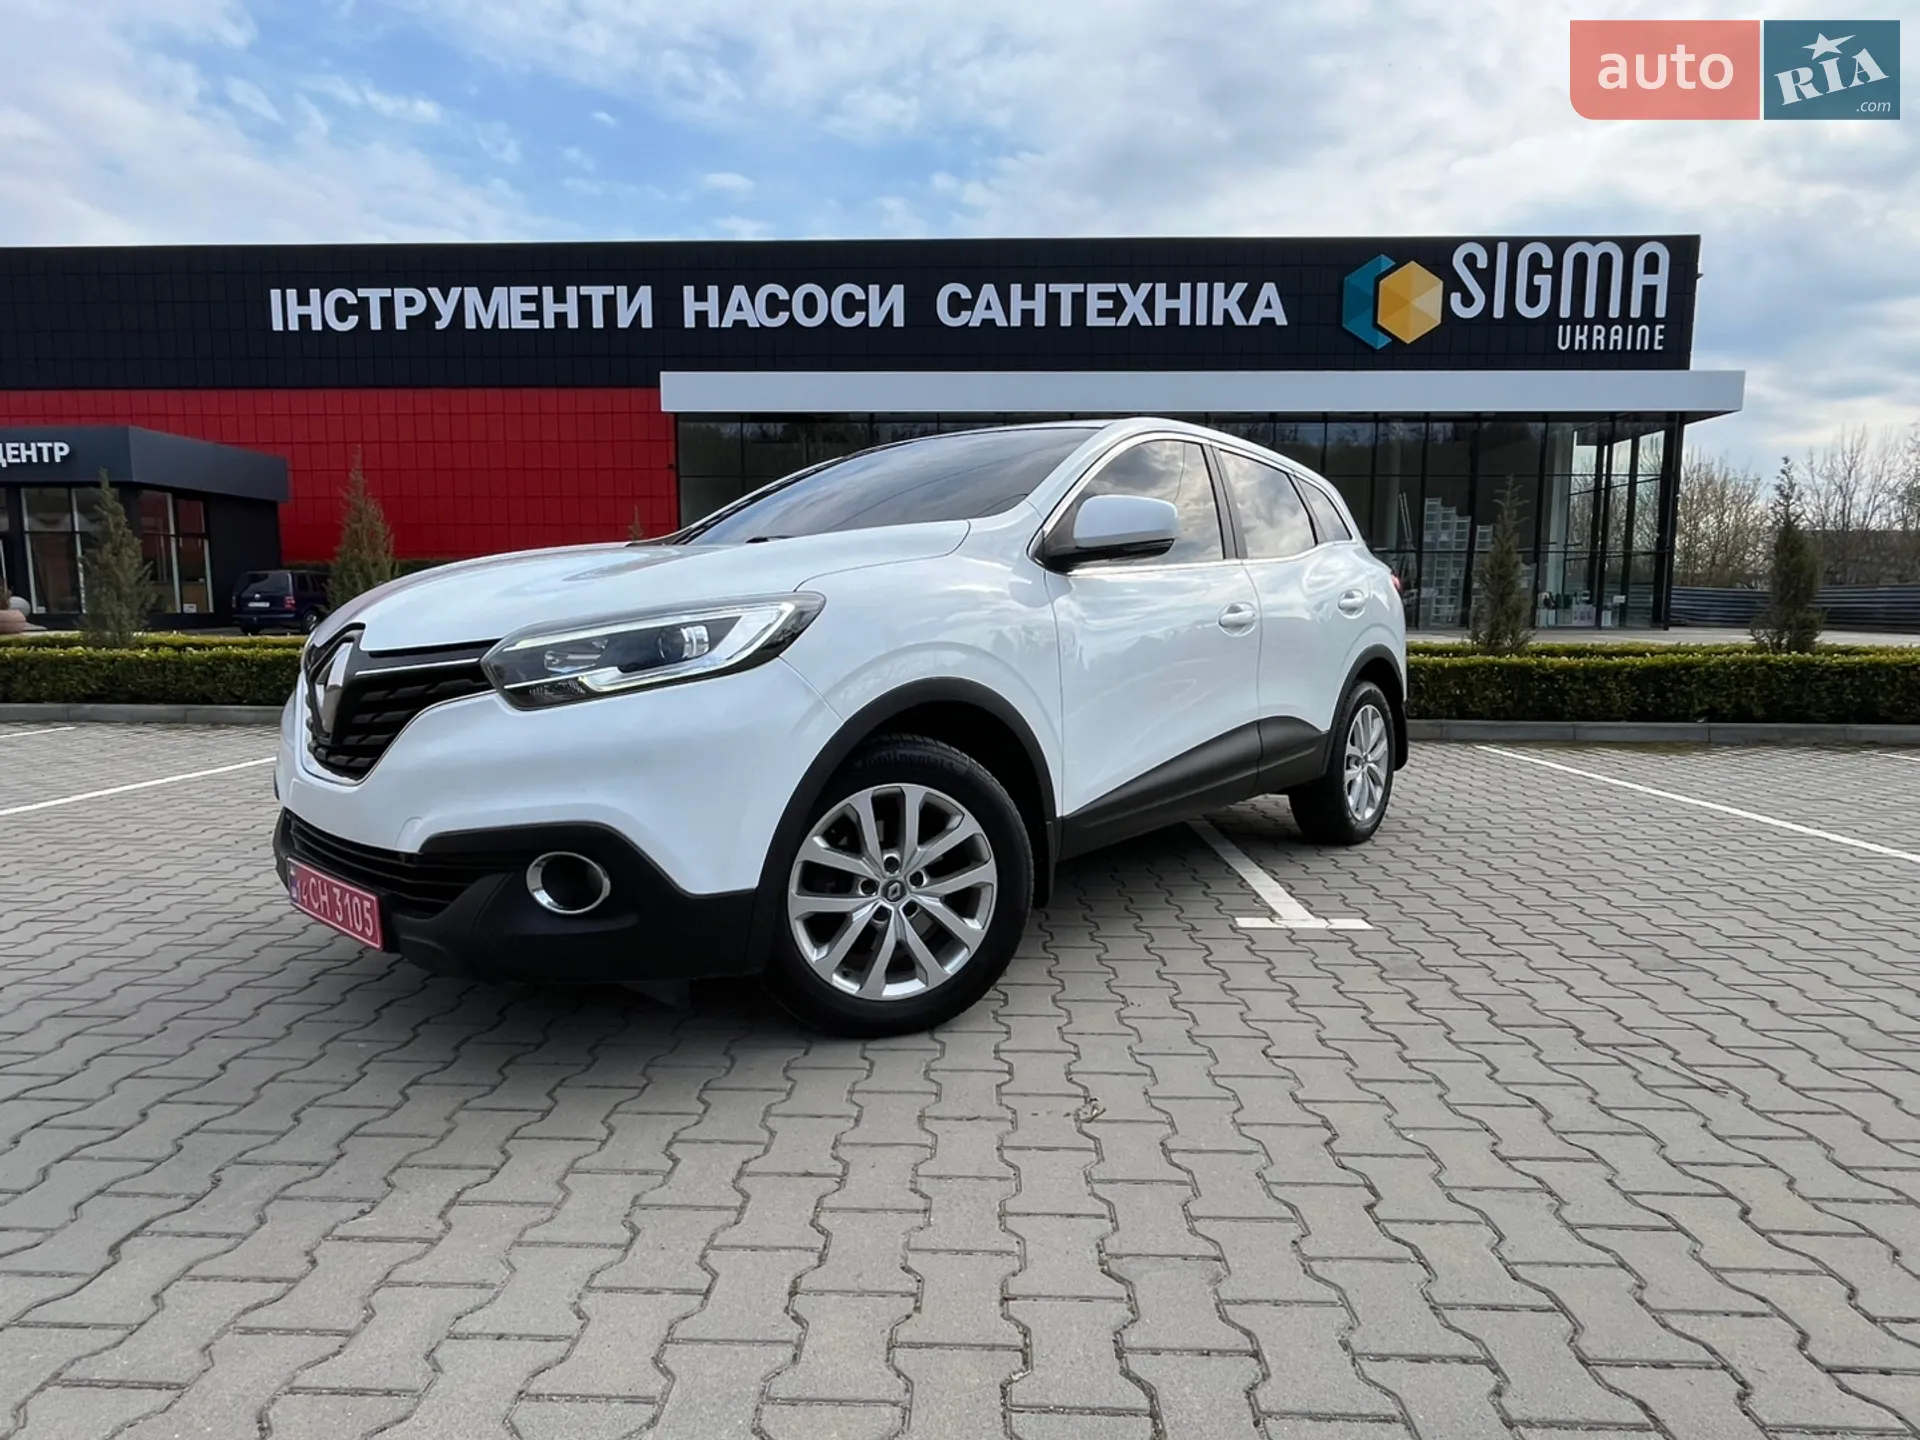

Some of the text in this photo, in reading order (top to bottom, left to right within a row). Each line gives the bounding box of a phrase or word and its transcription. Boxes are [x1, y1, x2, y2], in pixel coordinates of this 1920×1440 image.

[1450, 241, 1670, 319] SIGMA
[269, 282, 1288, 332] ІНСТРУМЕНТИ НАСОСИ САНТЕХНІКА
[1557, 324, 1665, 351] UKRAINE
[333, 887, 373, 937] 3105
